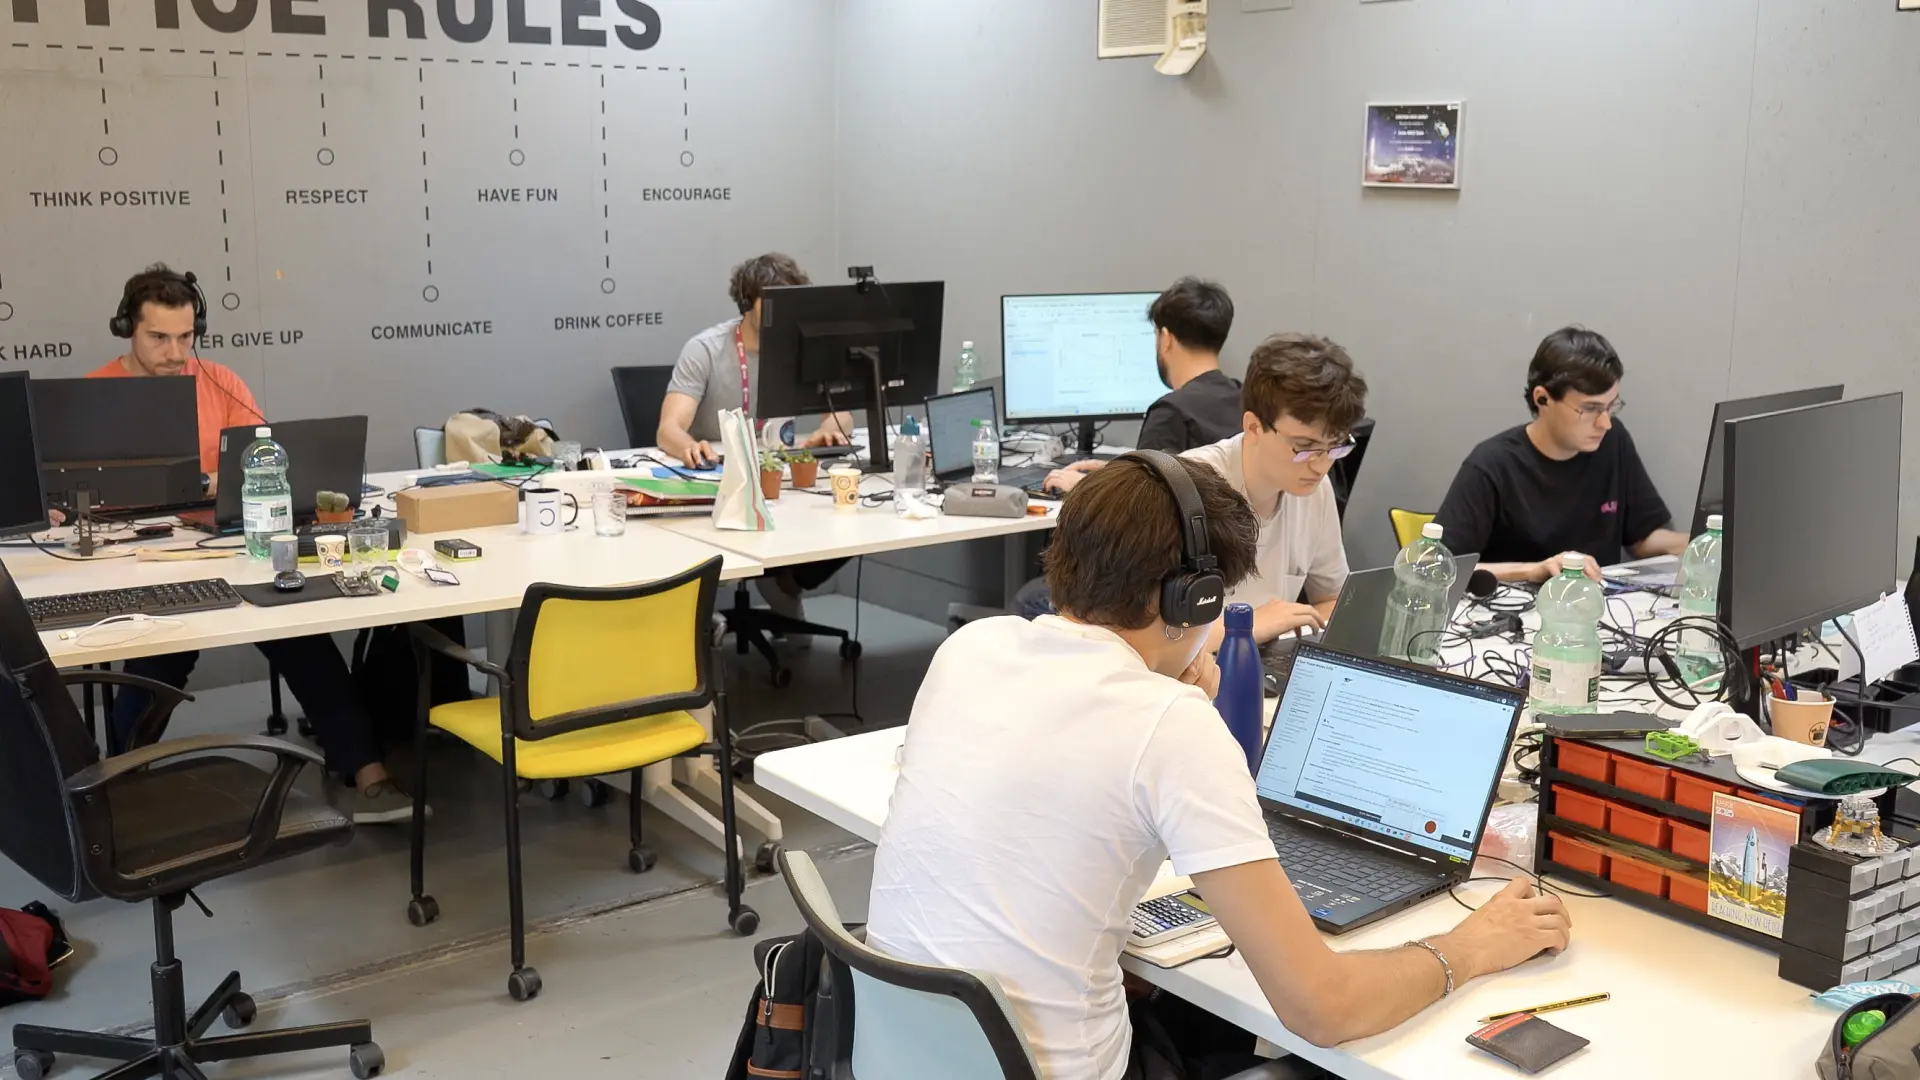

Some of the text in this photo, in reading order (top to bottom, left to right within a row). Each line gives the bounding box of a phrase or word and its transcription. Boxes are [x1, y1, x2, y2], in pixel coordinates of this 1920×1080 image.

[30, 191, 190, 207] THINK POSITIVE
[286, 190, 368, 204] RESPECT
[478, 188, 557, 202] HAVE FUN
[643, 188, 730, 202] ENCOURAGE
[554, 312, 662, 330] DRINK COFFEE
[232, 332, 273, 347] GIVE
[280, 330, 303, 344] UP
[371, 321, 492, 340] COMMUNICATE
[14, 343, 72, 360] HARD
